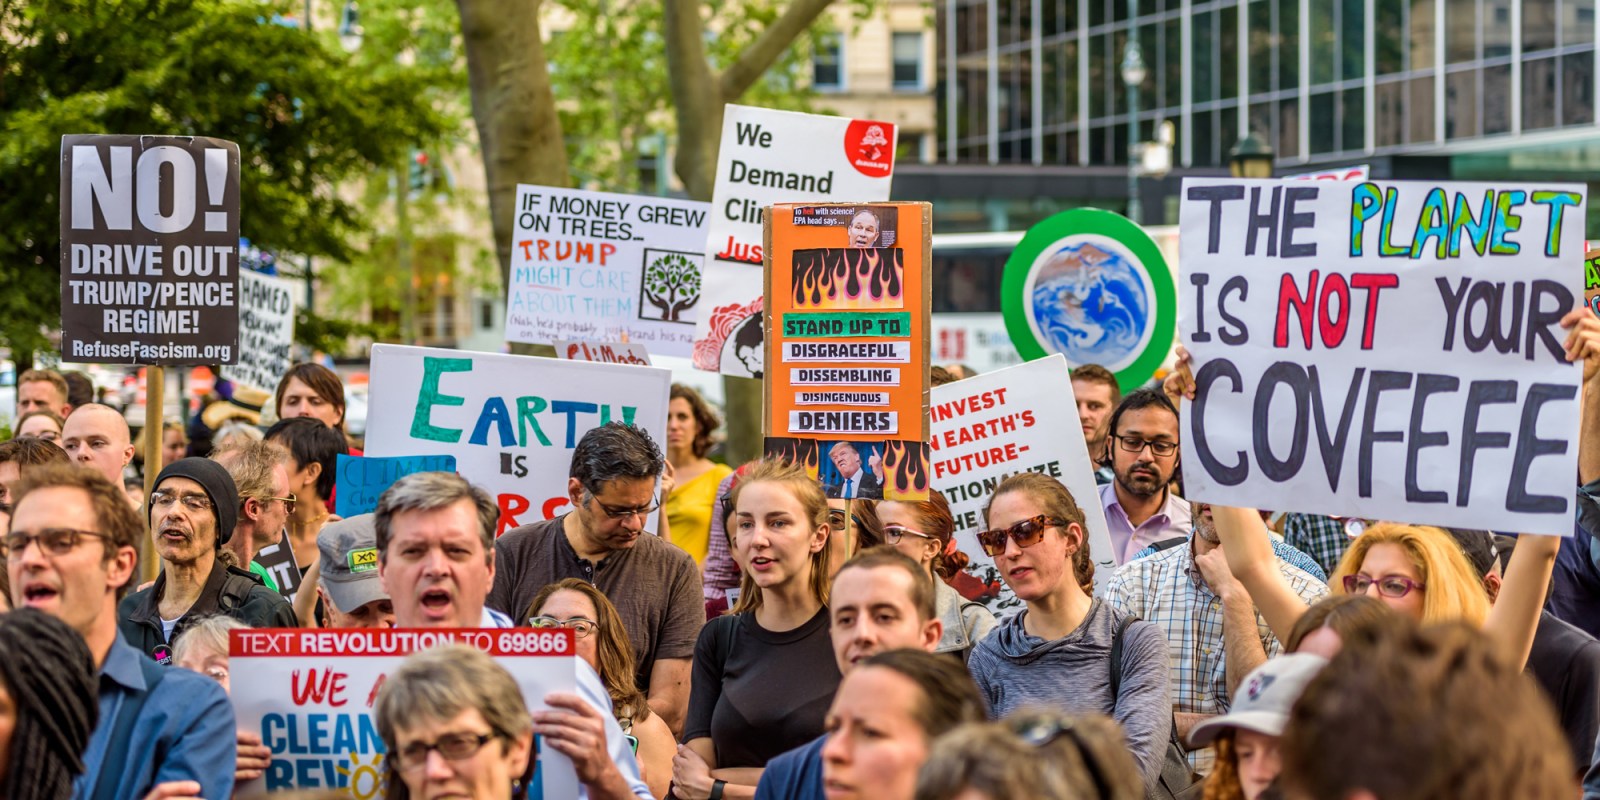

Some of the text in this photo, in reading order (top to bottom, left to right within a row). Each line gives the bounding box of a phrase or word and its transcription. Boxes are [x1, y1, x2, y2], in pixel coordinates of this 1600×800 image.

[736, 121, 773, 148] We
[71, 145, 228, 233] NO!
[729, 160, 834, 194] Demand
[519, 212, 551, 233] ON
[522, 193, 706, 228] IF MONEY GREW
[794, 217, 806, 225] EPA
[807, 217, 822, 225] head
[823, 218, 837, 226] says
[1187, 181, 1583, 260] THE PLANET
[71, 244, 233, 276] DRIVE OUT
[518, 239, 617, 266] TRUMP
[515, 266, 632, 292] MIGHT CARE
[69, 280, 234, 307] TRUMP/PENCE
[240, 276, 290, 315] HAMED
[511, 291, 632, 318] ABOUT THEM
[103, 310, 200, 334] REGIME!
[786, 319, 901, 335] STAND UP TO
[1190, 269, 1576, 366] IS NOT YOUR
[72, 340, 231, 361] RefuseFascism.org
[791, 343, 897, 358] DISGRACEFUL
[799, 370, 892, 382] DISSEMBLING
[802, 393, 882, 403] DISINGENUOUS
[798, 412, 890, 431] DENIERS
[943, 410, 1036, 448] EARTH'S
[1191, 357, 1579, 514] COVFEFE
[499, 452, 529, 478] IS
[238, 633, 568, 653] TEXT REVOLUTION TO 69866
[291, 665, 348, 707] WE
[261, 713, 387, 754] CLEAN
